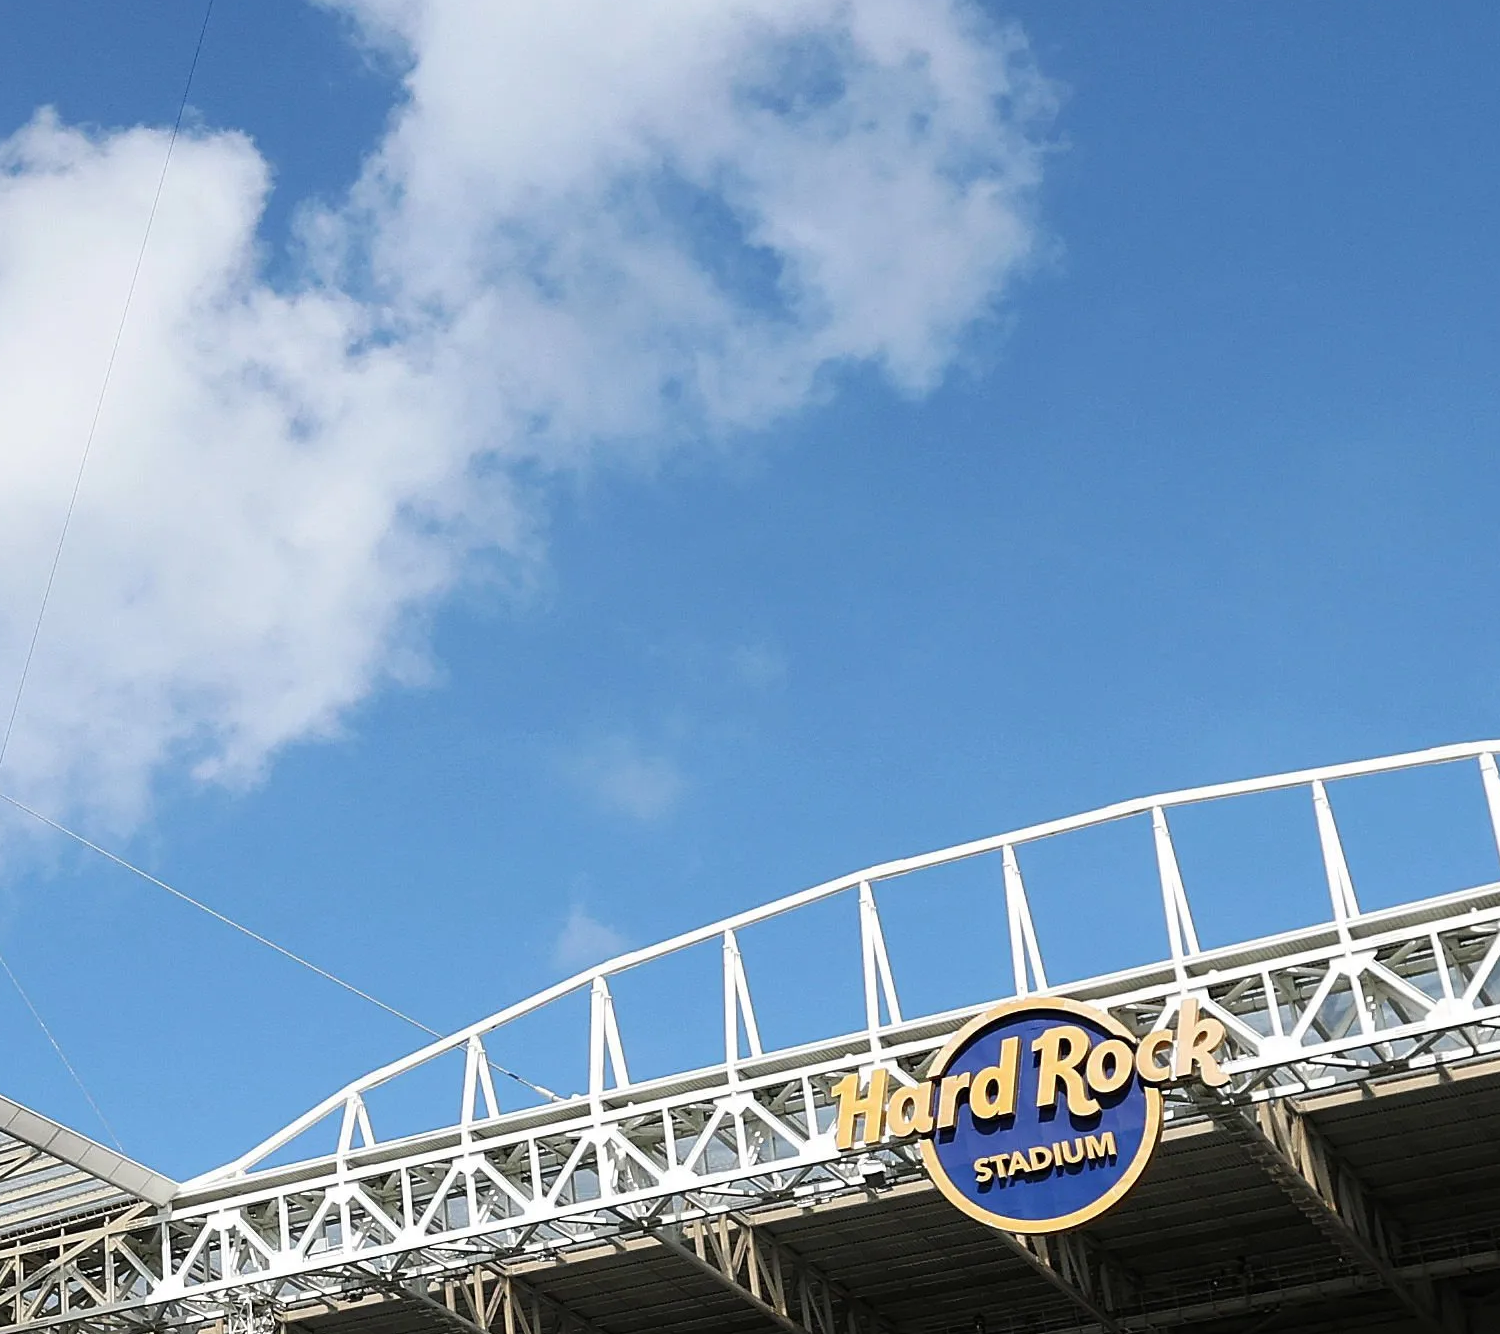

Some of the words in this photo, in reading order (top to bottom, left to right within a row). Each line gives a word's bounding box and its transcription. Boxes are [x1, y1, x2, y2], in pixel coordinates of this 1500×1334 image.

[831, 1035, 1020, 1151] Hard
[1031, 999, 1232, 1118] Rock
[973, 1132, 1117, 1183] STADIUM
